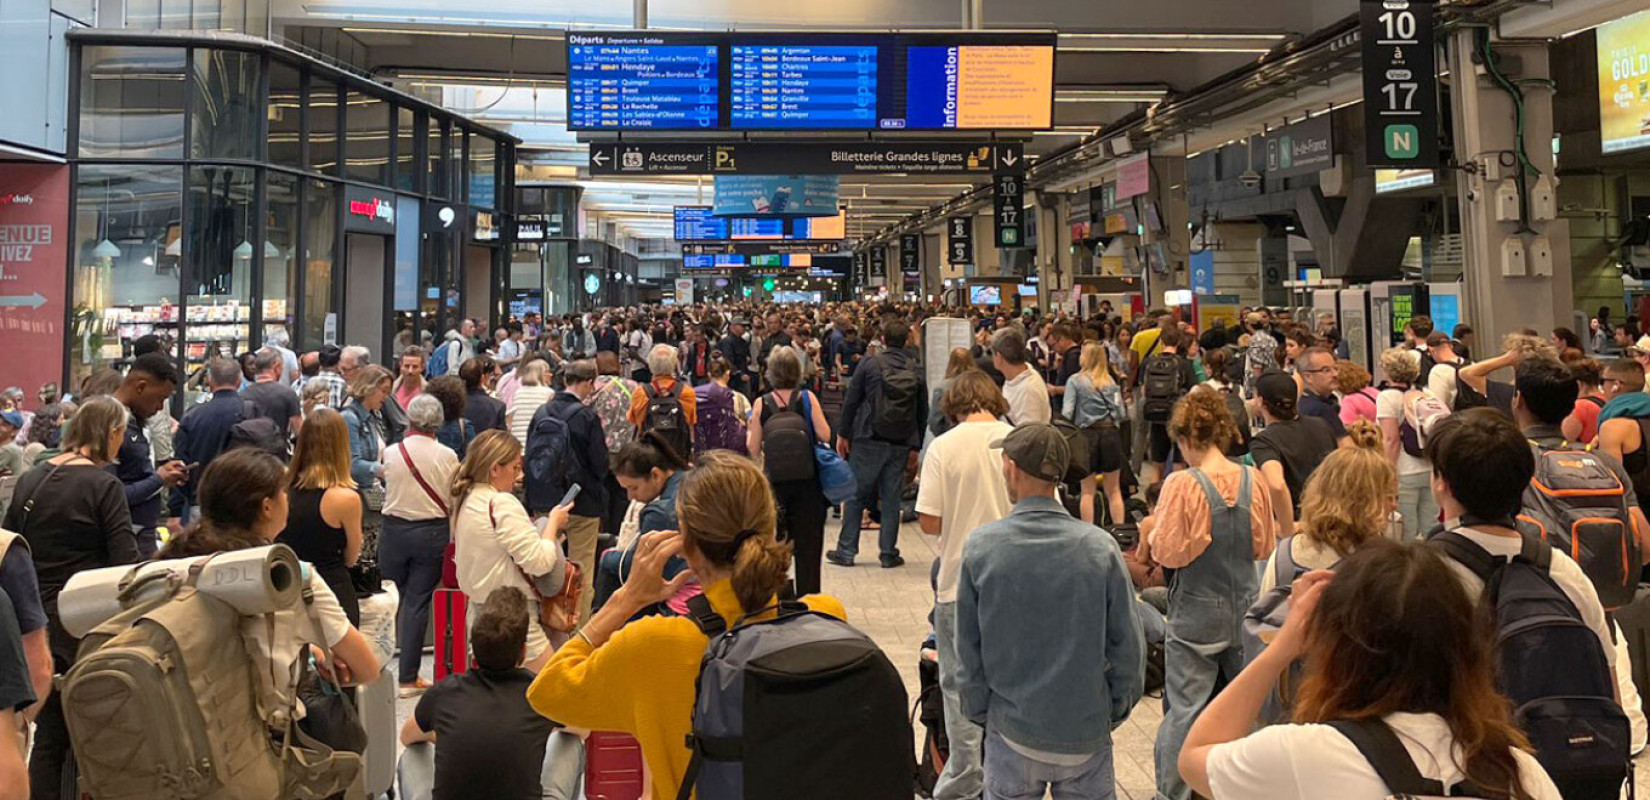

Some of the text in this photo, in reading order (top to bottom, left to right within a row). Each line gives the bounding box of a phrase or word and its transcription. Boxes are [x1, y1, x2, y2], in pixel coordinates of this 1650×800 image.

[1378, 11, 1416, 39] 10
[569, 34, 604, 45] Départs
[781, 47, 811, 55] Argentan
[1394, 46, 1402, 59] à
[621, 63, 655, 71] Hendaye
[1612, 52, 1650, 80] GOLD
[1388, 70, 1409, 79] Voie
[781, 79, 809, 87] Hendaye
[853, 49, 872, 119] départs
[943, 47, 957, 127] information
[1381, 83, 1418, 110] 17
[781, 111, 809, 119] Quimper
[1393, 132, 1410, 151] N
[649, 152, 704, 162] Ascenseur
[716, 151, 735, 167] P1
[831, 151, 963, 164] Billetterie Grandes lignes
[1000, 182, 1016, 194] 10
[1001, 212, 1017, 223] 17
[956, 224, 964, 236] 8
[956, 248, 964, 259] 9
[1267, 267, 1279, 285] 9
